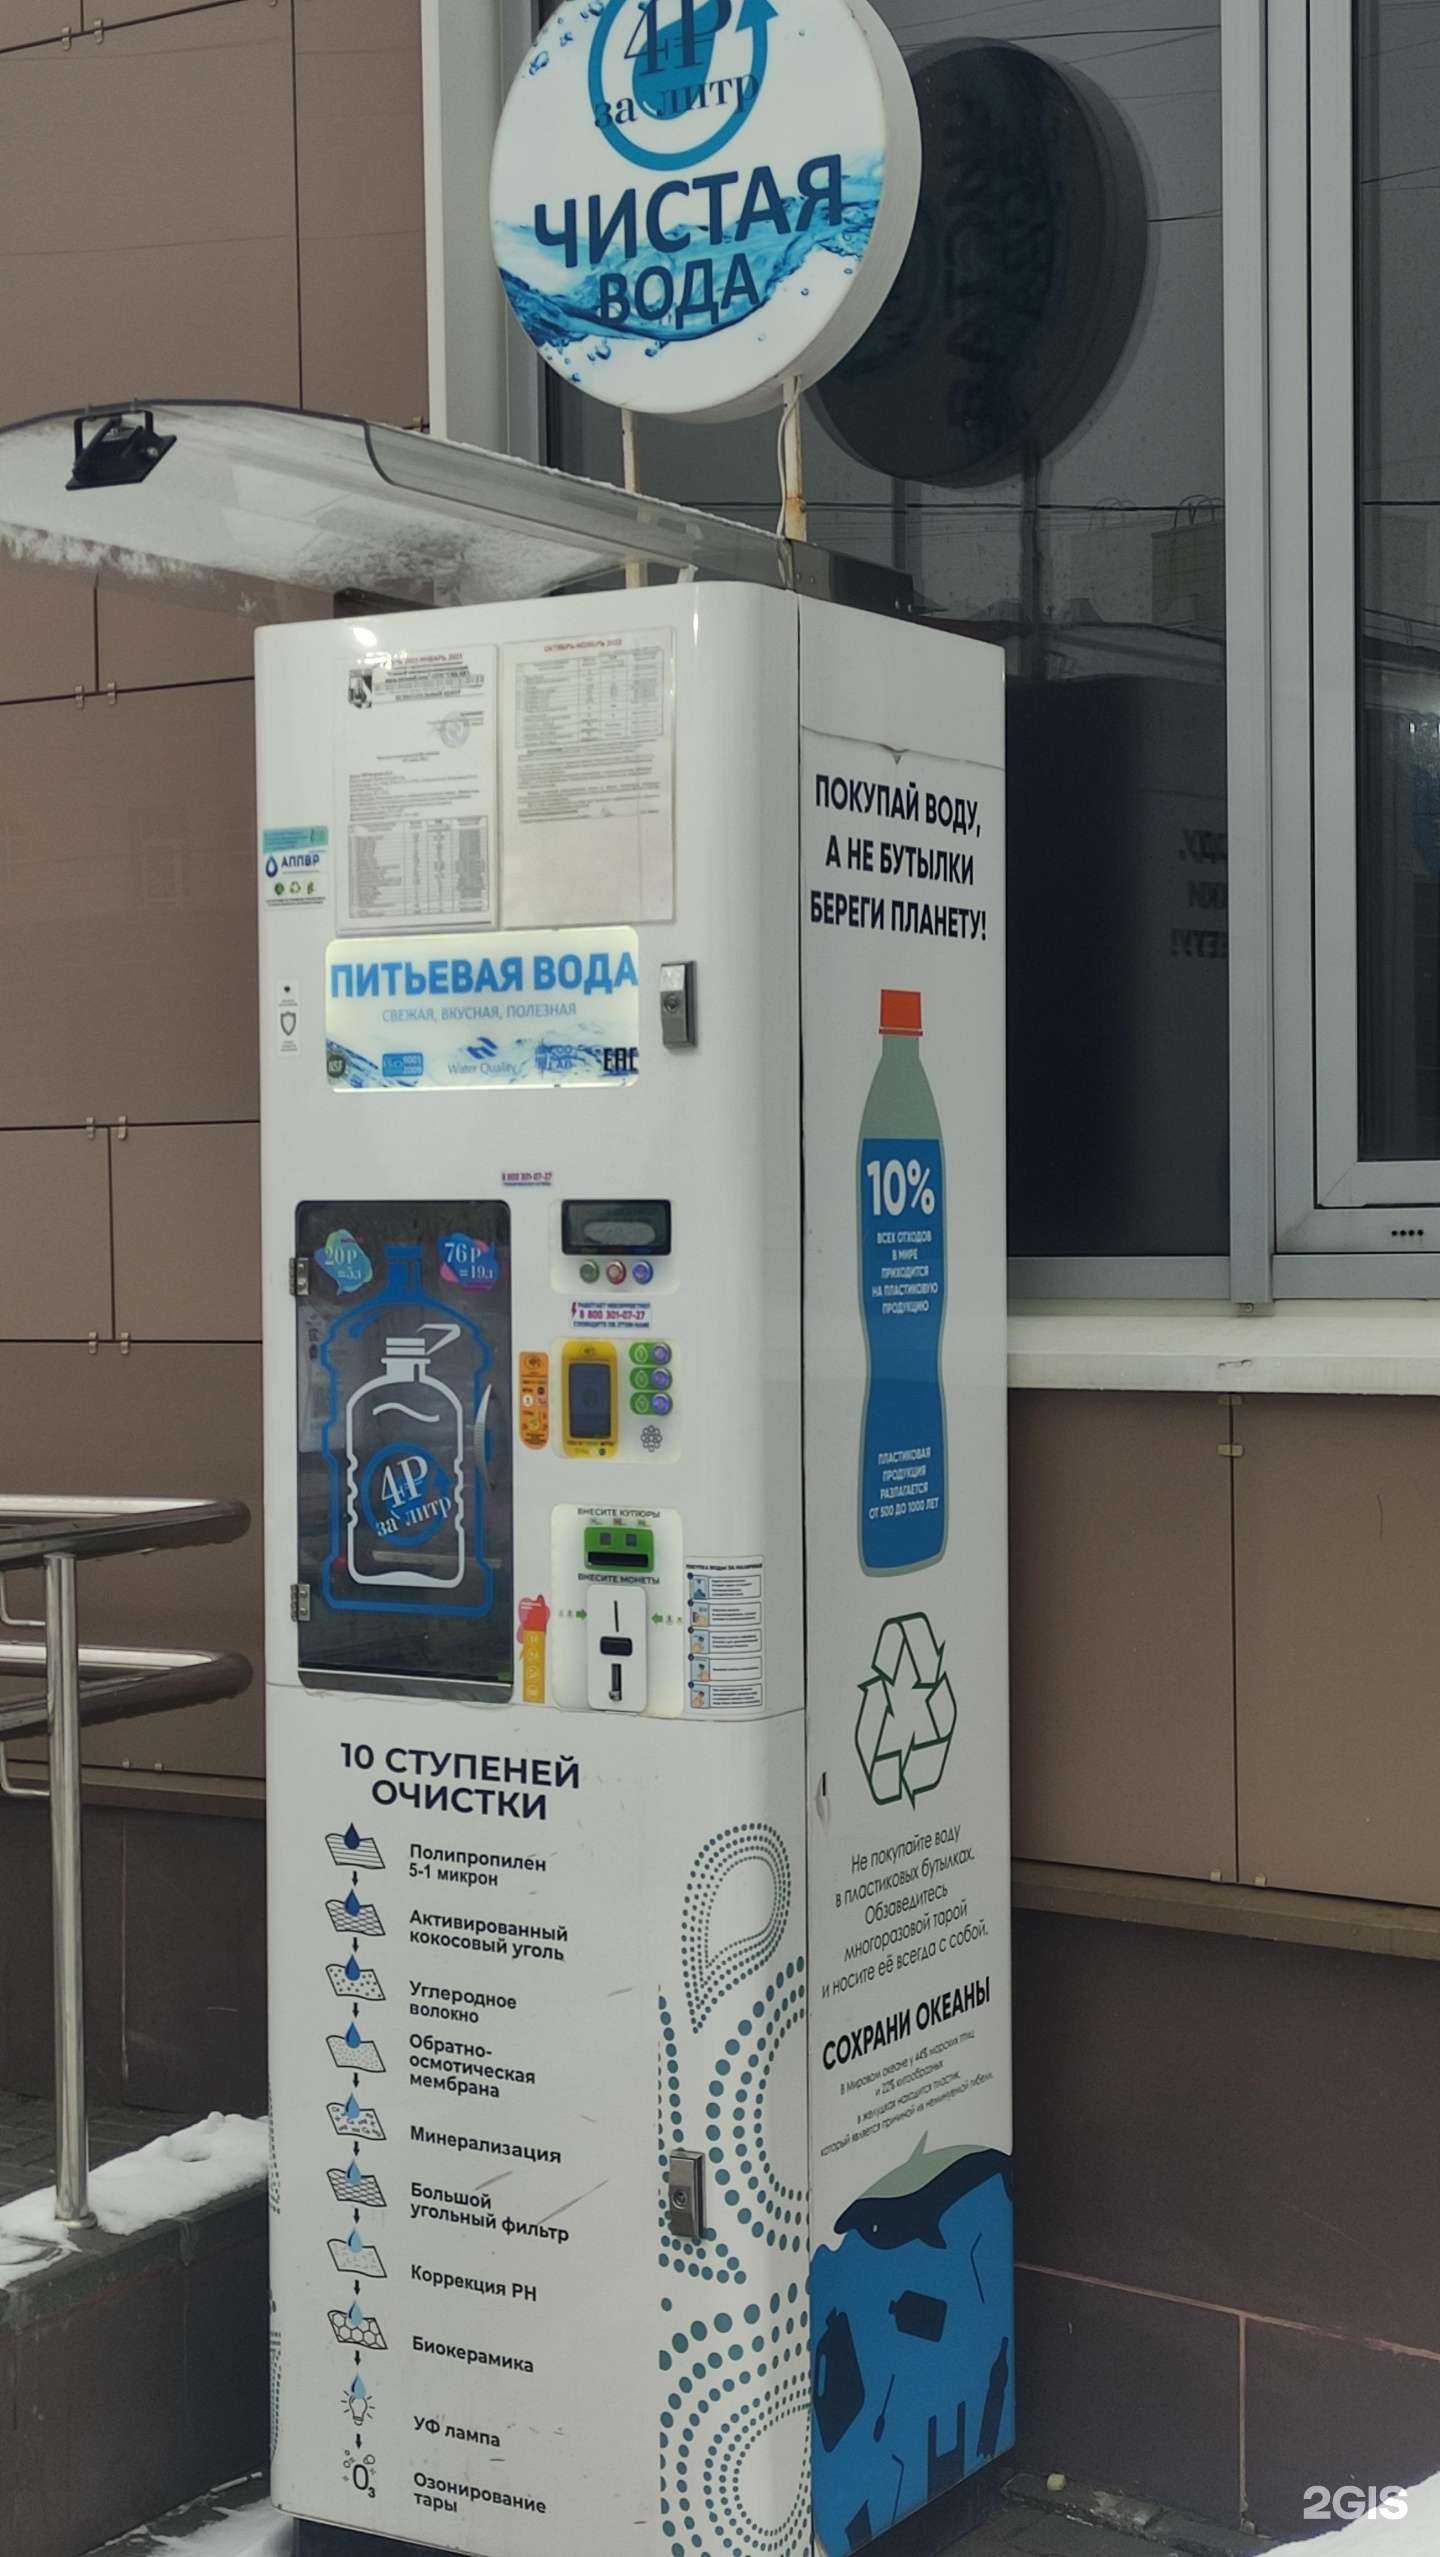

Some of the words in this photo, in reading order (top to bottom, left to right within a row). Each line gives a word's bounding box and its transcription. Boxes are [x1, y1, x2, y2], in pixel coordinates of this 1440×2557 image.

[594, 96, 638, 129] за
[656, 74, 760, 117] литр
[534, 154, 843, 268] ЧИСТАЯ
[599, 253, 759, 330] ВОДА
[816, 774, 919, 821] ПОКУПАЙ
[926, 793, 981, 838] ВОДУ,
[825, 834, 841, 869] А
[848, 837, 874, 872] НЕ
[880, 842, 973, 885] БУТЫЛКИ
[811, 890, 884, 930] БЕРЕГИ
[891, 900, 986, 941] ПЛАНЕТУ!
[331, 956, 523, 998] ПИТЬЕВАЯ
[533, 952, 639, 994] ВОДА
[382, 1006, 437, 1024] СВЕЖАЯ,
[441, 1006, 503, 1022] ВКУСНАЯ,
[506, 1002, 577, 1019] ПОЛЕЗНАЯ
[867, 1159, 935, 1216] 10%
[877, 1232, 895, 1244] ВСЕХ
[897, 1231, 931, 1243] ОТХОДОВ
[881, 1266, 929, 1279] ПРИХОДИТСЯ
[882, 1301, 929, 1314] ПРОДУКЦИЮ
[878, 1447, 931, 1464] ПЛАСТИКОВАЯ
[882, 1465, 926, 1481] ПРОДУКЦИЯ
[880, 1482, 928, 1499] РАЗЛАГАЕТСЯ
[376, 1517, 398, 1536] за
[406, 1496, 451, 1526] литр
[577, 1508, 618, 1517] ВНЕСИТЕ
[869, 1508, 879, 1519] ОТ
[895, 1502, 907, 1516] ДО
[926, 1497, 939, 1510] ЛЕТ
[578, 1573, 618, 1583] ВНЕСИТЕ
[621, 1575, 660, 1584] МОНЕТЫ
[341, 1743, 374, 1770] 10
[385, 1748, 579, 1789] СТУПЕНЕЙ
[372, 1780, 546, 1820] ОЧИСТКИ
[410, 1844, 546, 1872] Полипропилен
[851, 1853, 867, 1873] Не
[871, 1834, 932, 1867] покупайте
[934, 1824, 961, 1846] воду
[409, 1863, 431, 1879] 5-1
[437, 1870, 498, 1887] микрон
[835, 1893, 841, 1908] в
[844, 1865, 919, 1905] пластиковых
[921, 1848, 975, 1879] бутылках.
[865, 1883, 949, 1925] Обзаведитесь
[410, 1910, 568, 1942] Активированный
[844, 1912, 931, 1962] многоразовой
[933, 1899, 968, 1928] тарой
[410, 1930, 507, 1954] кокосовый
[512, 1942, 564, 1962] уголь
[821, 1984, 830, 1999] и
[833, 1965, 875, 1995] носите
[878, 1954, 894, 1977] её
[897, 1942, 936, 1970] всегда
[939, 1937, 947, 1952] с
[949, 1919, 988, 1949] собой.
[410, 1980, 517, 2010] Углеродное
[410, 2002, 479, 2023] волокно
[822, 2009, 910, 2070] СОХРАНИ
[916, 1976, 990, 2030] ОКЕАНЫ
[410, 2034, 492, 2057] Обратно-
[410, 2054, 536, 2084] осмотическая
[410, 2072, 500, 2098] мембрана
[411, 2125, 562, 2163] Минерализация
[411, 2182, 491, 2209] Большой
[411, 2204, 497, 2229] угольный
[502, 2216, 569, 2244] фильтр
[411, 2265, 506, 2297] Коррекция
[413, 2336, 534, 2373] Биокерамика
[414, 2416, 440, 2435] УФ
[445, 2426, 500, 2447] лампа
[414, 2472, 546, 2513] Озонирование
[414, 2493, 457, 2512] тары
